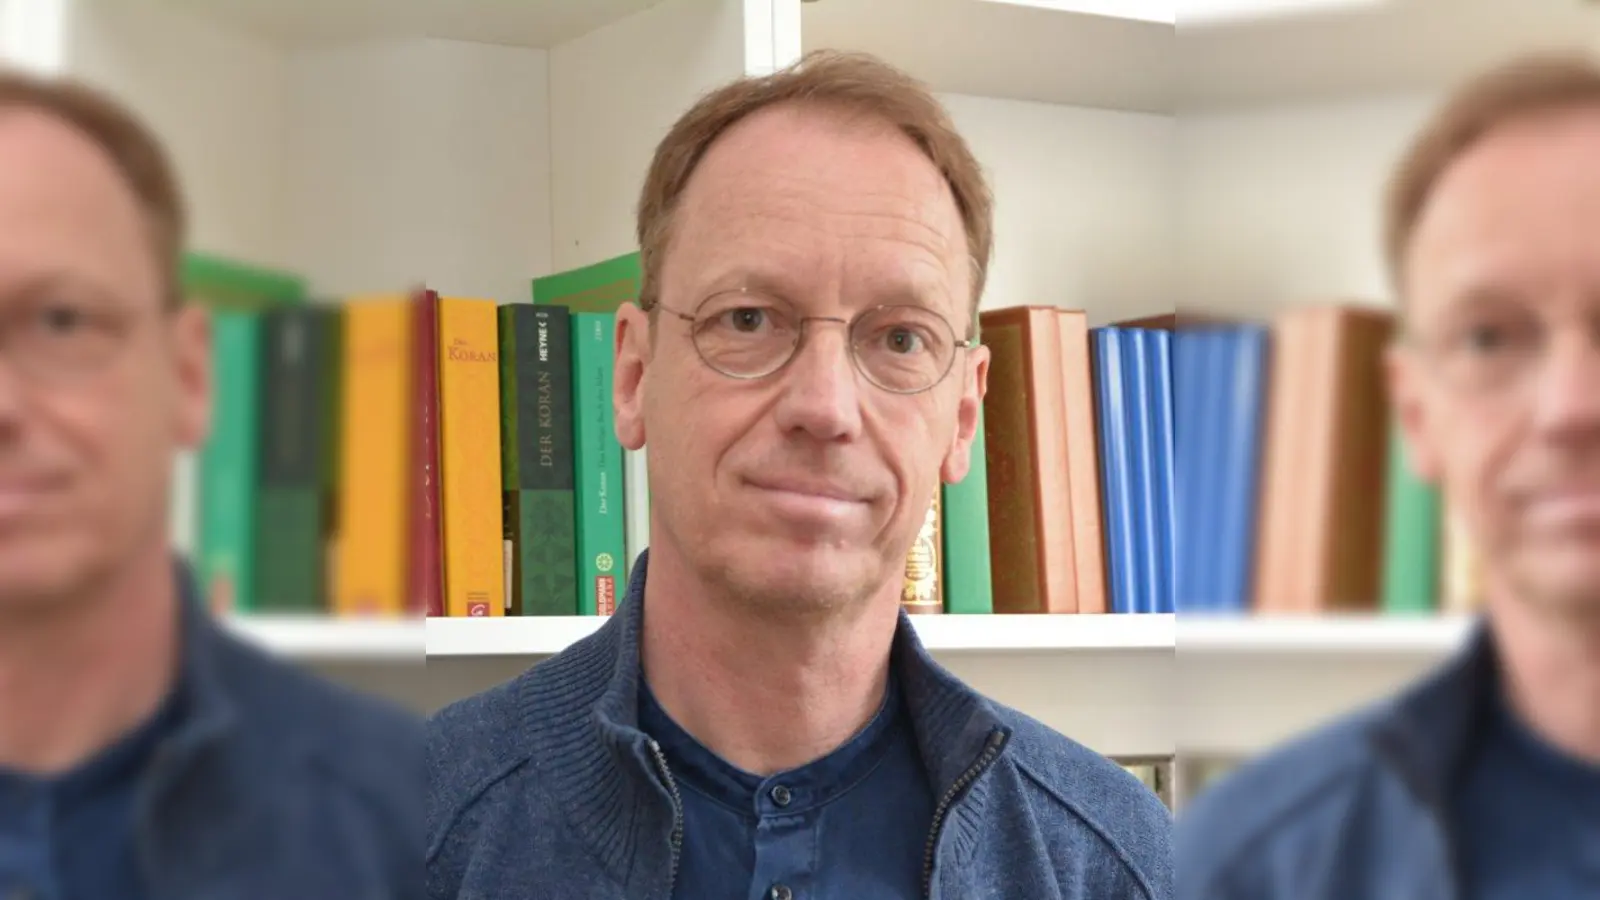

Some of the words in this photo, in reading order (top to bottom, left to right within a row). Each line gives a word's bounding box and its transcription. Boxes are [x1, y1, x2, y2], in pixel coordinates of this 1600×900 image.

[538, 326, 549, 362] HEYNE
[538, 372, 552, 427] KORAN
[540, 434, 552, 467] DER
